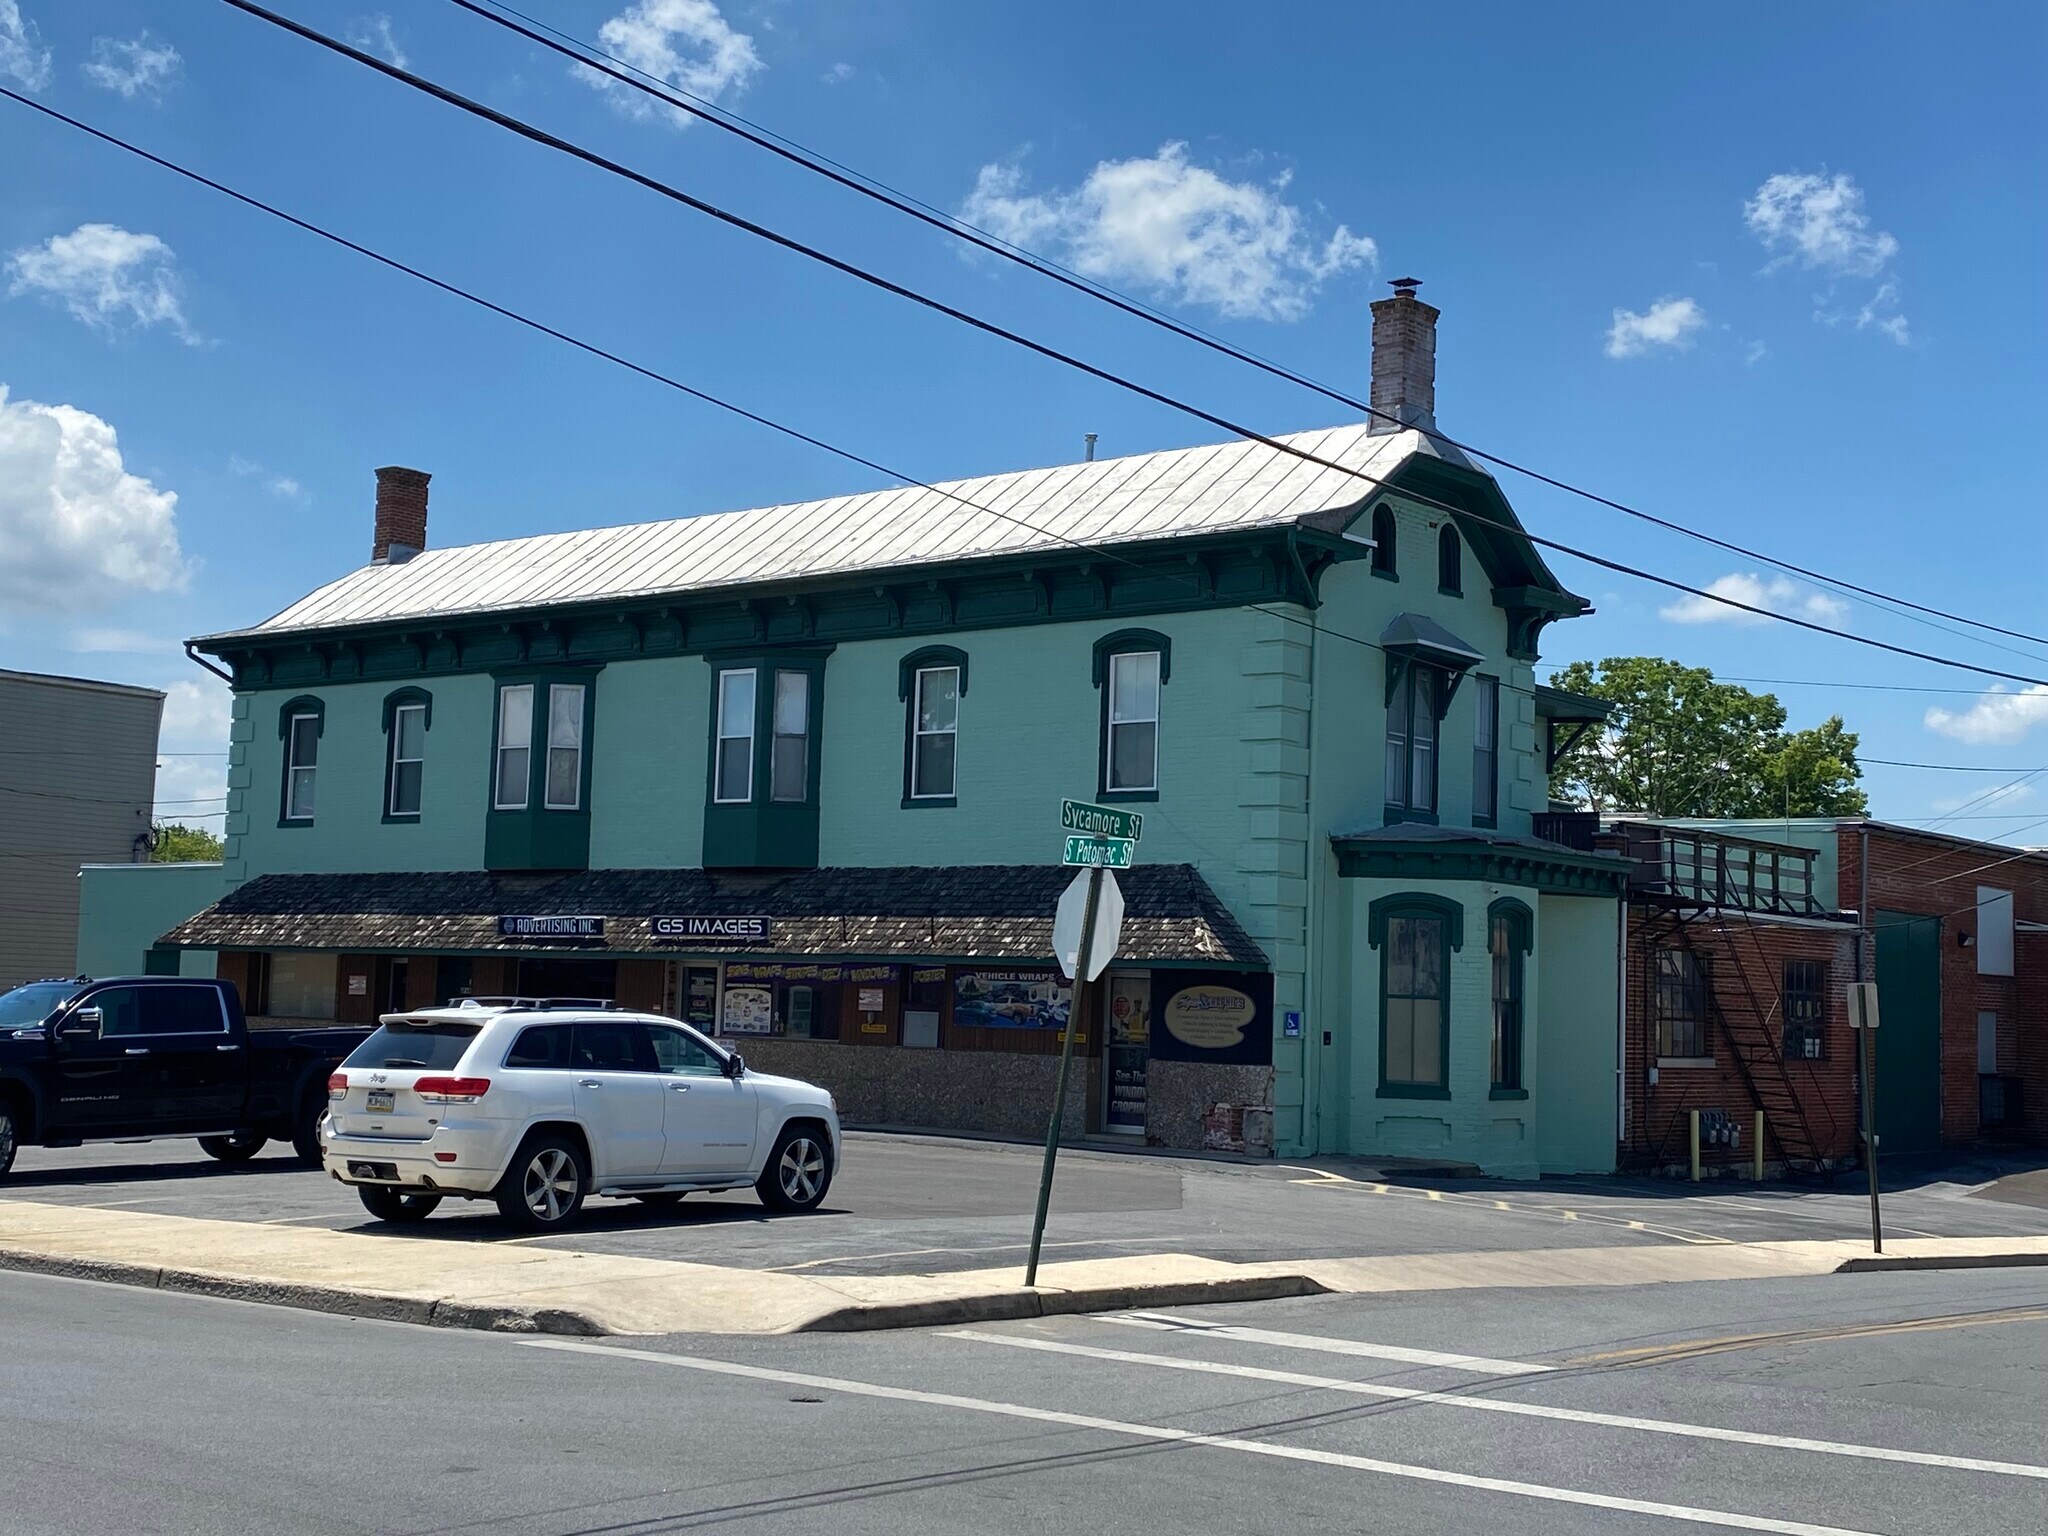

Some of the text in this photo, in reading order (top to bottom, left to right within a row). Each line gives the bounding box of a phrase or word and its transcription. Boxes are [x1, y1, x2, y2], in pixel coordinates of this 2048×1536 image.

[1064, 802, 1140, 838] Sycamore St
[1065, 840, 1132, 865] S Potomac St
[516, 918, 597, 933] ADVERTISING INC.
[657, 919, 762, 934] GS IMAGES
[753, 964, 783, 979] WRAPS
[975, 972, 1015, 981] VEHICLE
[1018, 973, 1055, 982] WRAPS
